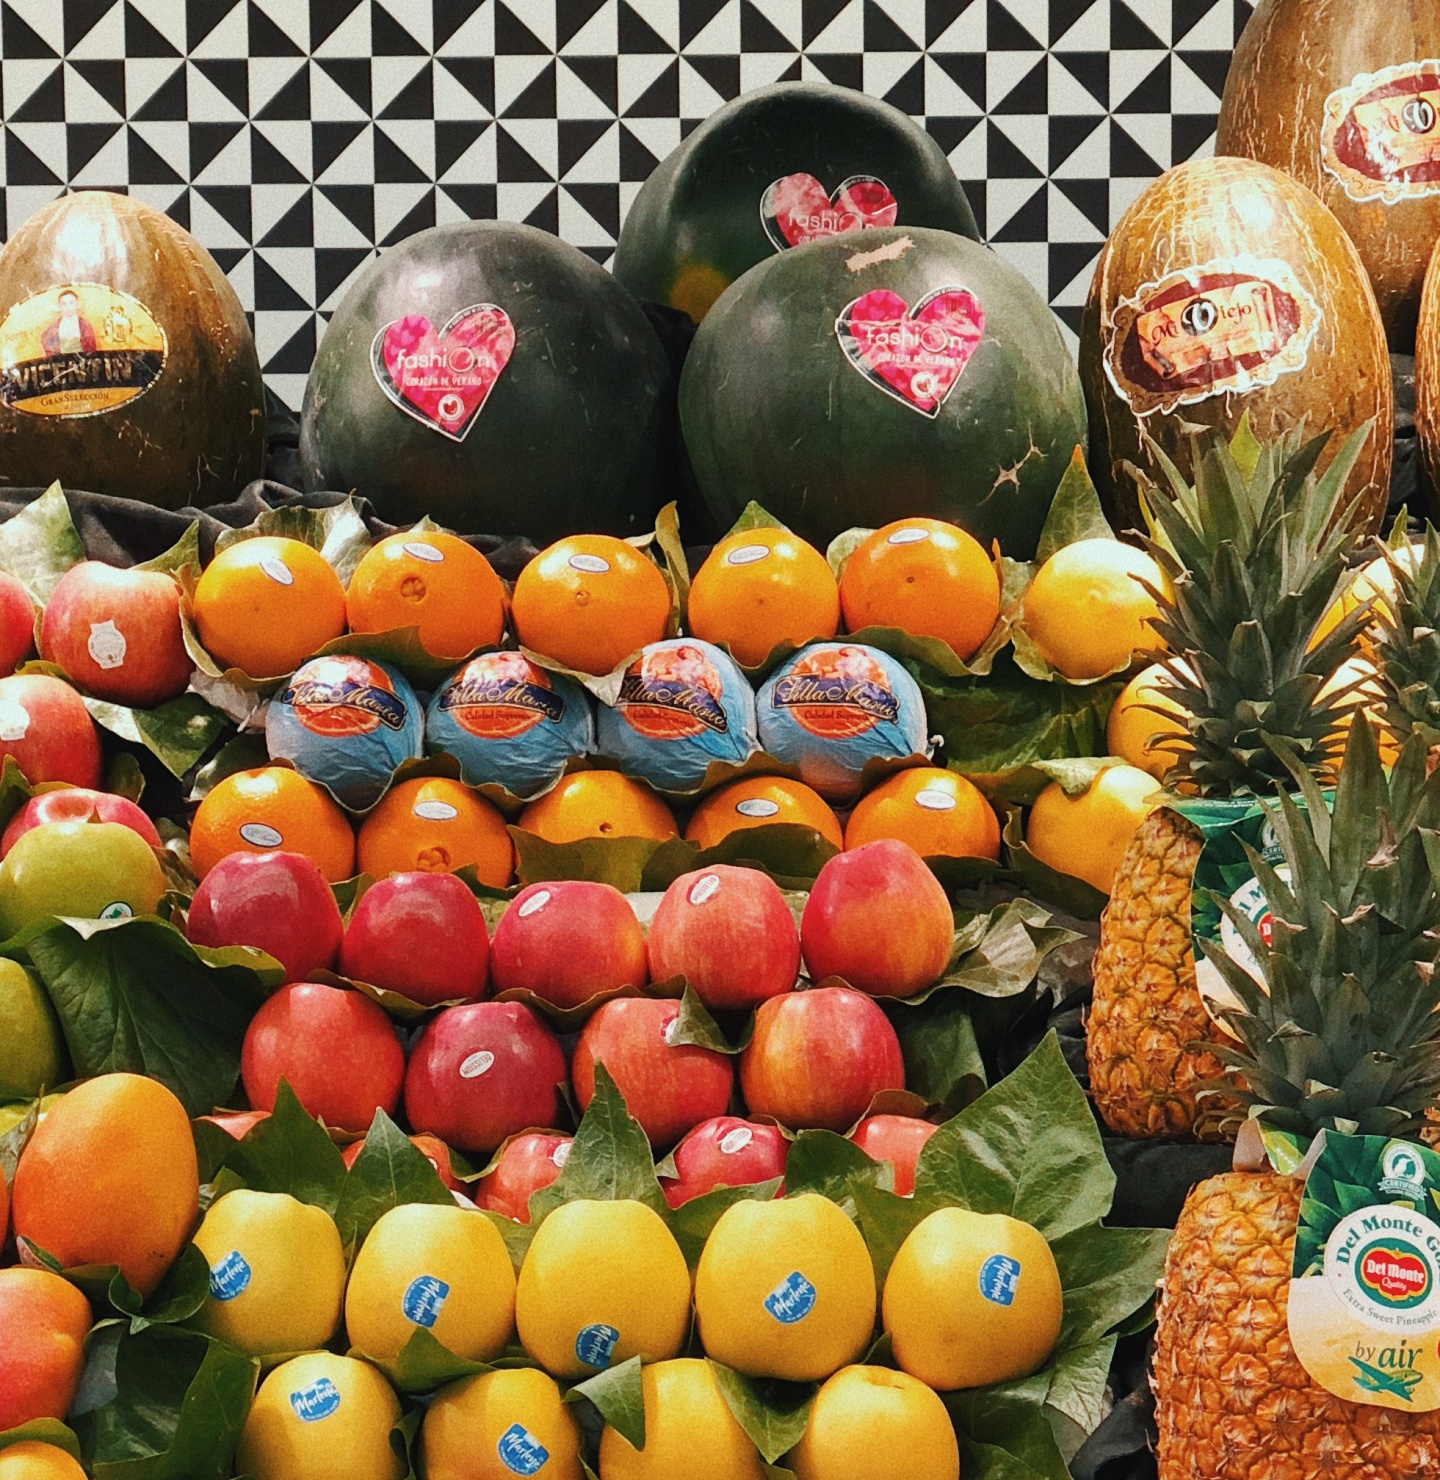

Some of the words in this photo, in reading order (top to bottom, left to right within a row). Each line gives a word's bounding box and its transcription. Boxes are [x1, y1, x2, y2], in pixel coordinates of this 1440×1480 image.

[1151, 320, 1179, 346] Mi
[461, 1052, 493, 1076] DELISSIUM
[1336, 1227, 1361, 1265] Del
[1361, 1214, 1423, 1238] Monte
[990, 1258, 1014, 1300] Marlene
[1366, 1259, 1387, 1276] Del
[1387, 1263, 1425, 1284] Monte
[412, 1280, 440, 1321] Marlene
[773, 1281, 811, 1317] Marlene
[1342, 1288, 1366, 1312] Extra
[1366, 1306, 1394, 1324] Sweet
[1396, 1308, 1438, 1326] Pineapple
[587, 1325, 612, 1364] Marlene
[1355, 1340, 1376, 1362] by
[1377, 1339, 1423, 1369] air
[504, 1432, 541, 1467] Marlene
